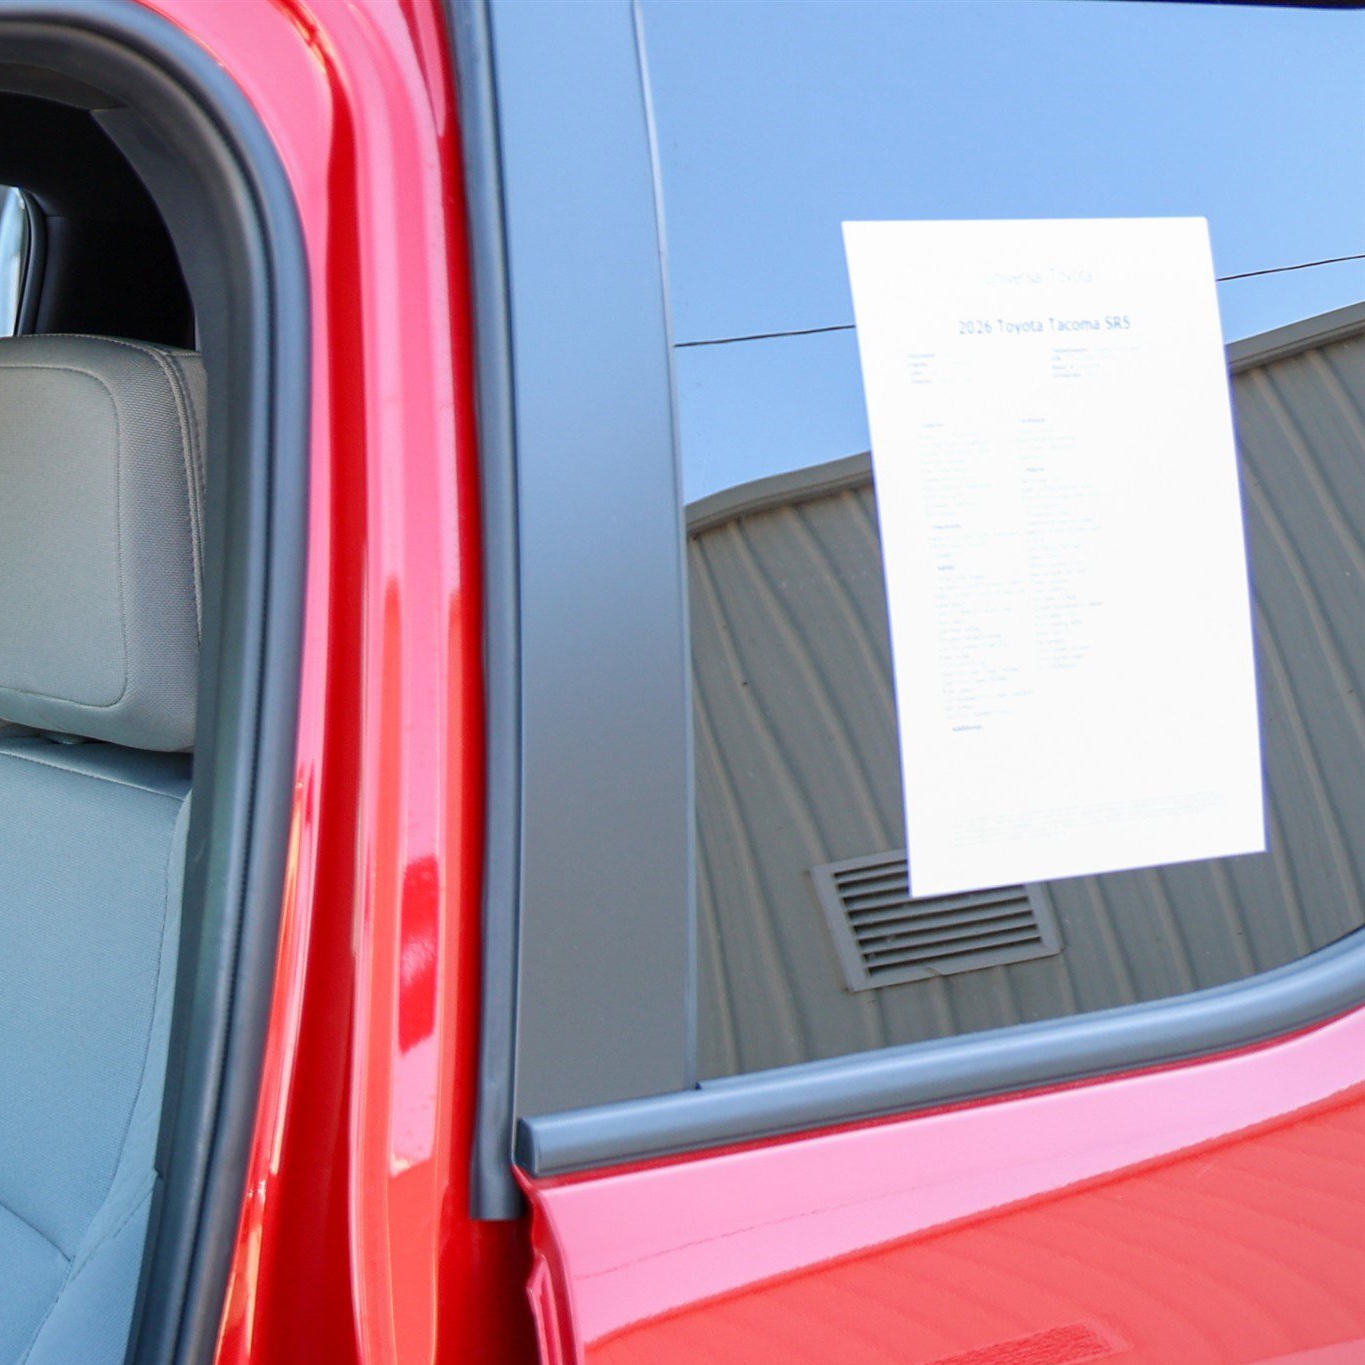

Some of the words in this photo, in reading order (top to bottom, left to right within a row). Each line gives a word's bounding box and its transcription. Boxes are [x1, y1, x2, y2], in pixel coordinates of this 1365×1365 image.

[958, 320, 993, 335] 2026
[997, 318, 1044, 335] Toyota
[1048, 316, 1101, 332] Tacoma
[1104, 314, 1132, 331] SR5
